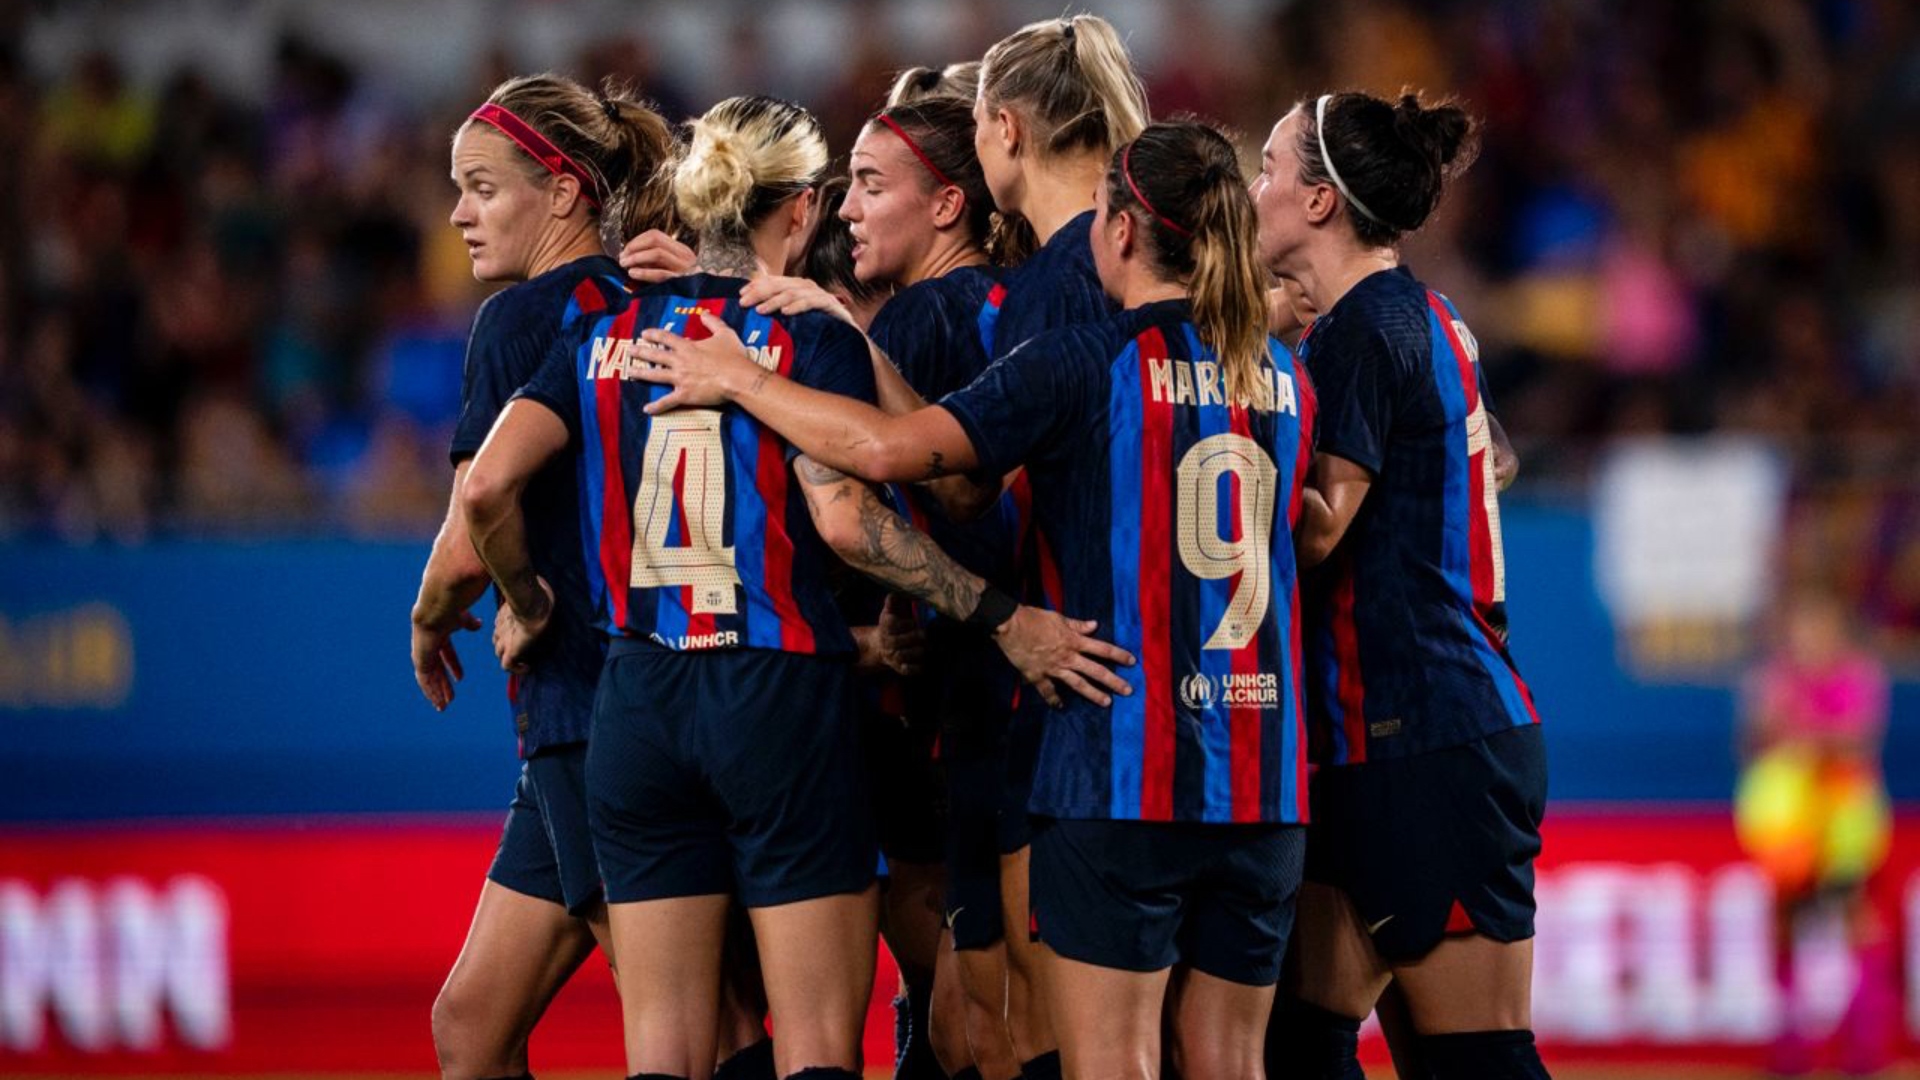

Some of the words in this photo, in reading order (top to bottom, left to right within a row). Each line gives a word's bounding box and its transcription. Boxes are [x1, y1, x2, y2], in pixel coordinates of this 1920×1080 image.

[1147, 357, 1298, 418] MARINA
[629, 409, 743, 615] 4
[1176, 432, 1278, 651] 9
[679, 630, 739, 650] UNHCR
[1222, 673, 1278, 688] UNHCR
[1222, 688, 1279, 703] ACNUR
